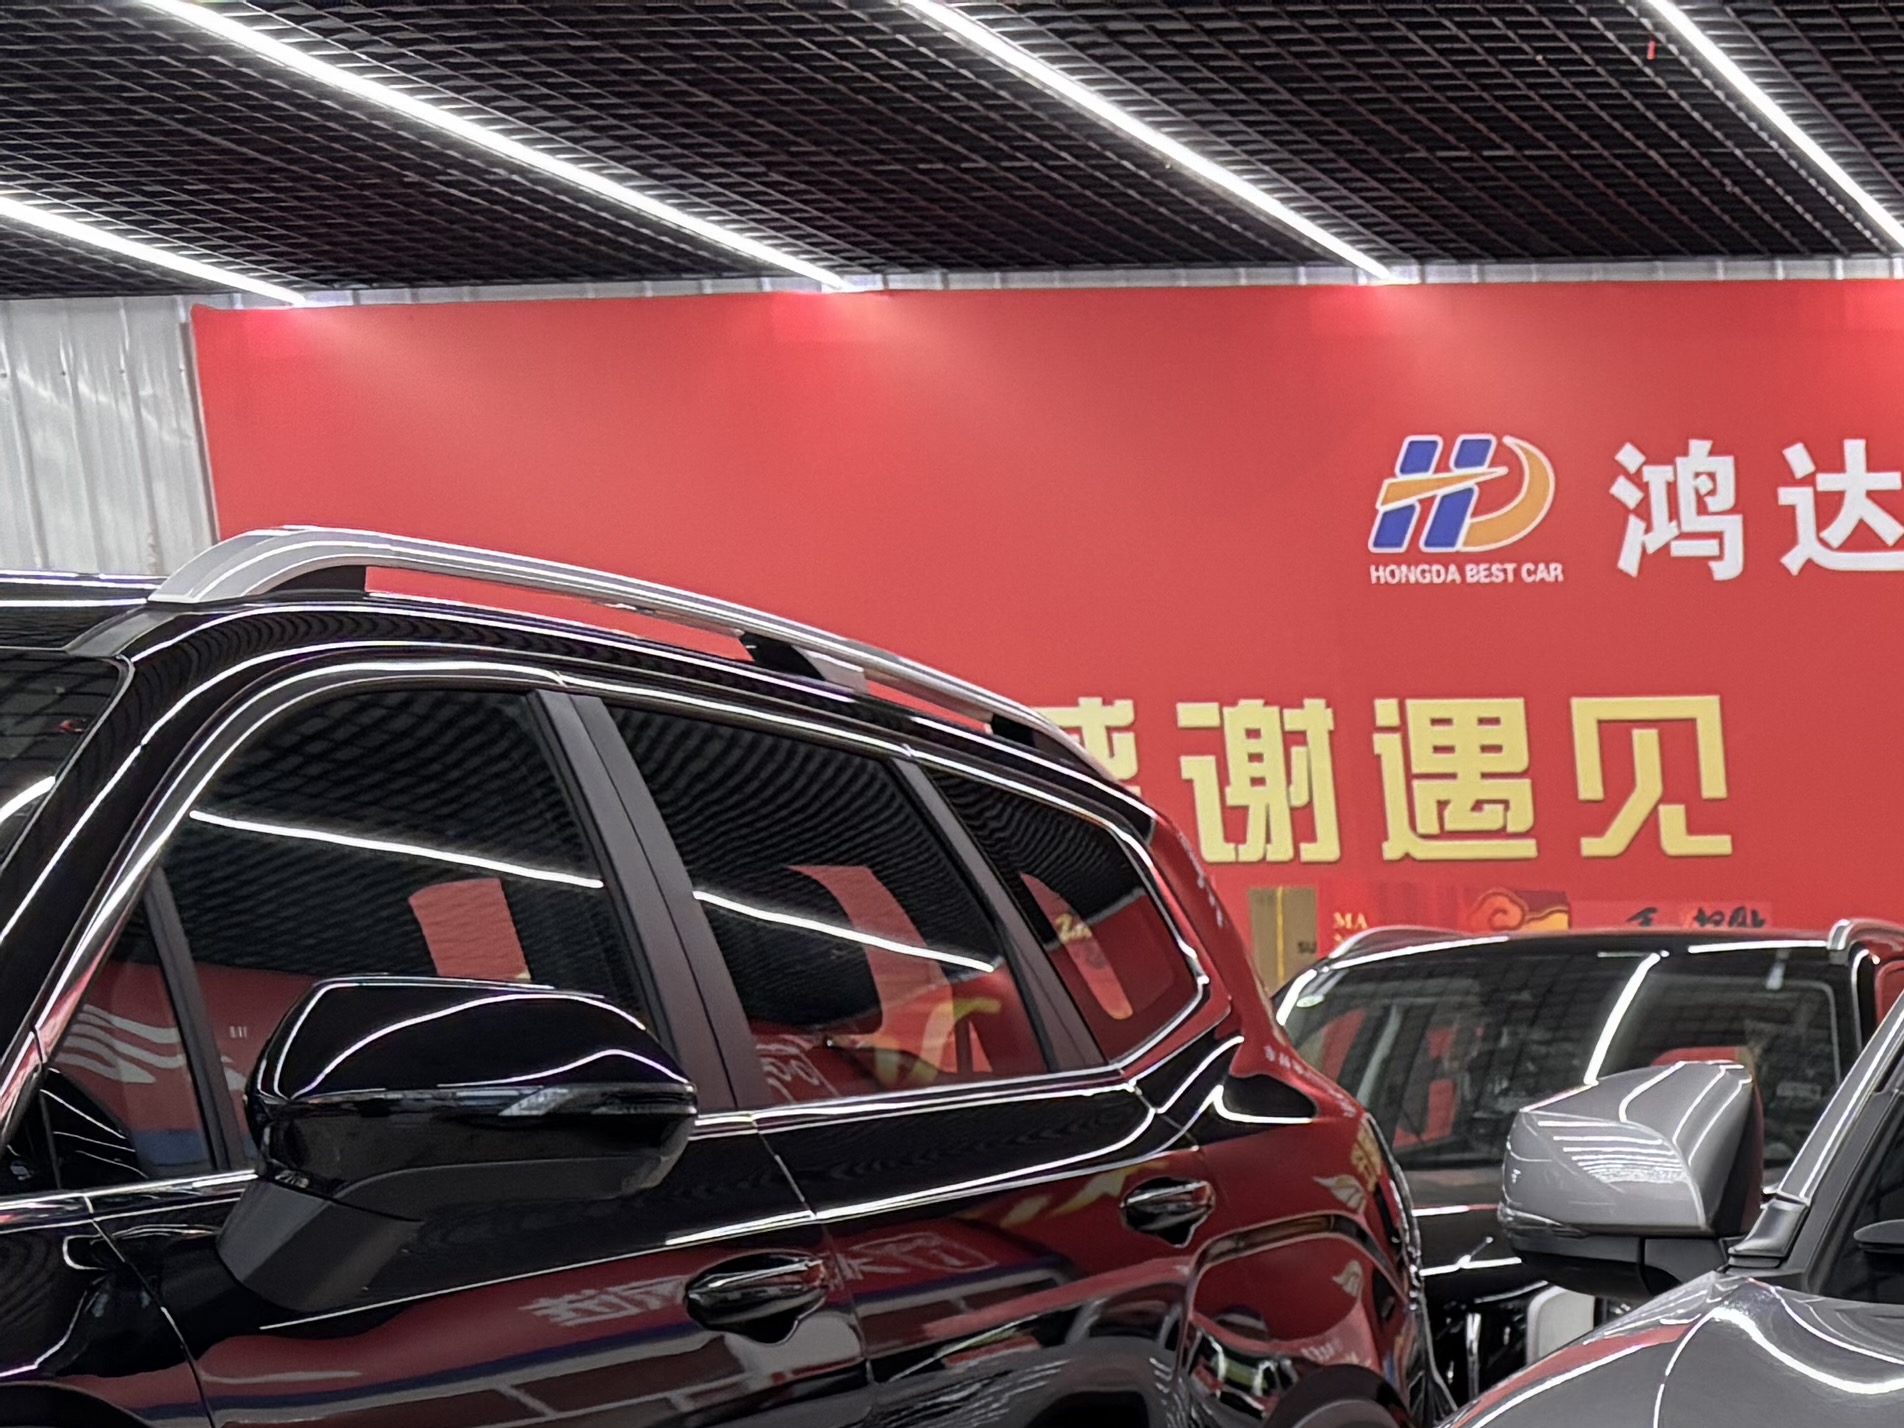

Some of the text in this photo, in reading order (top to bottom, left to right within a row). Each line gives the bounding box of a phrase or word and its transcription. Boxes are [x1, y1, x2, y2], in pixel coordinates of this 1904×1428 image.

[1369, 562, 1564, 584] HONGDA BEST CAR
[1030, 696, 1732, 863] 谢遇见
